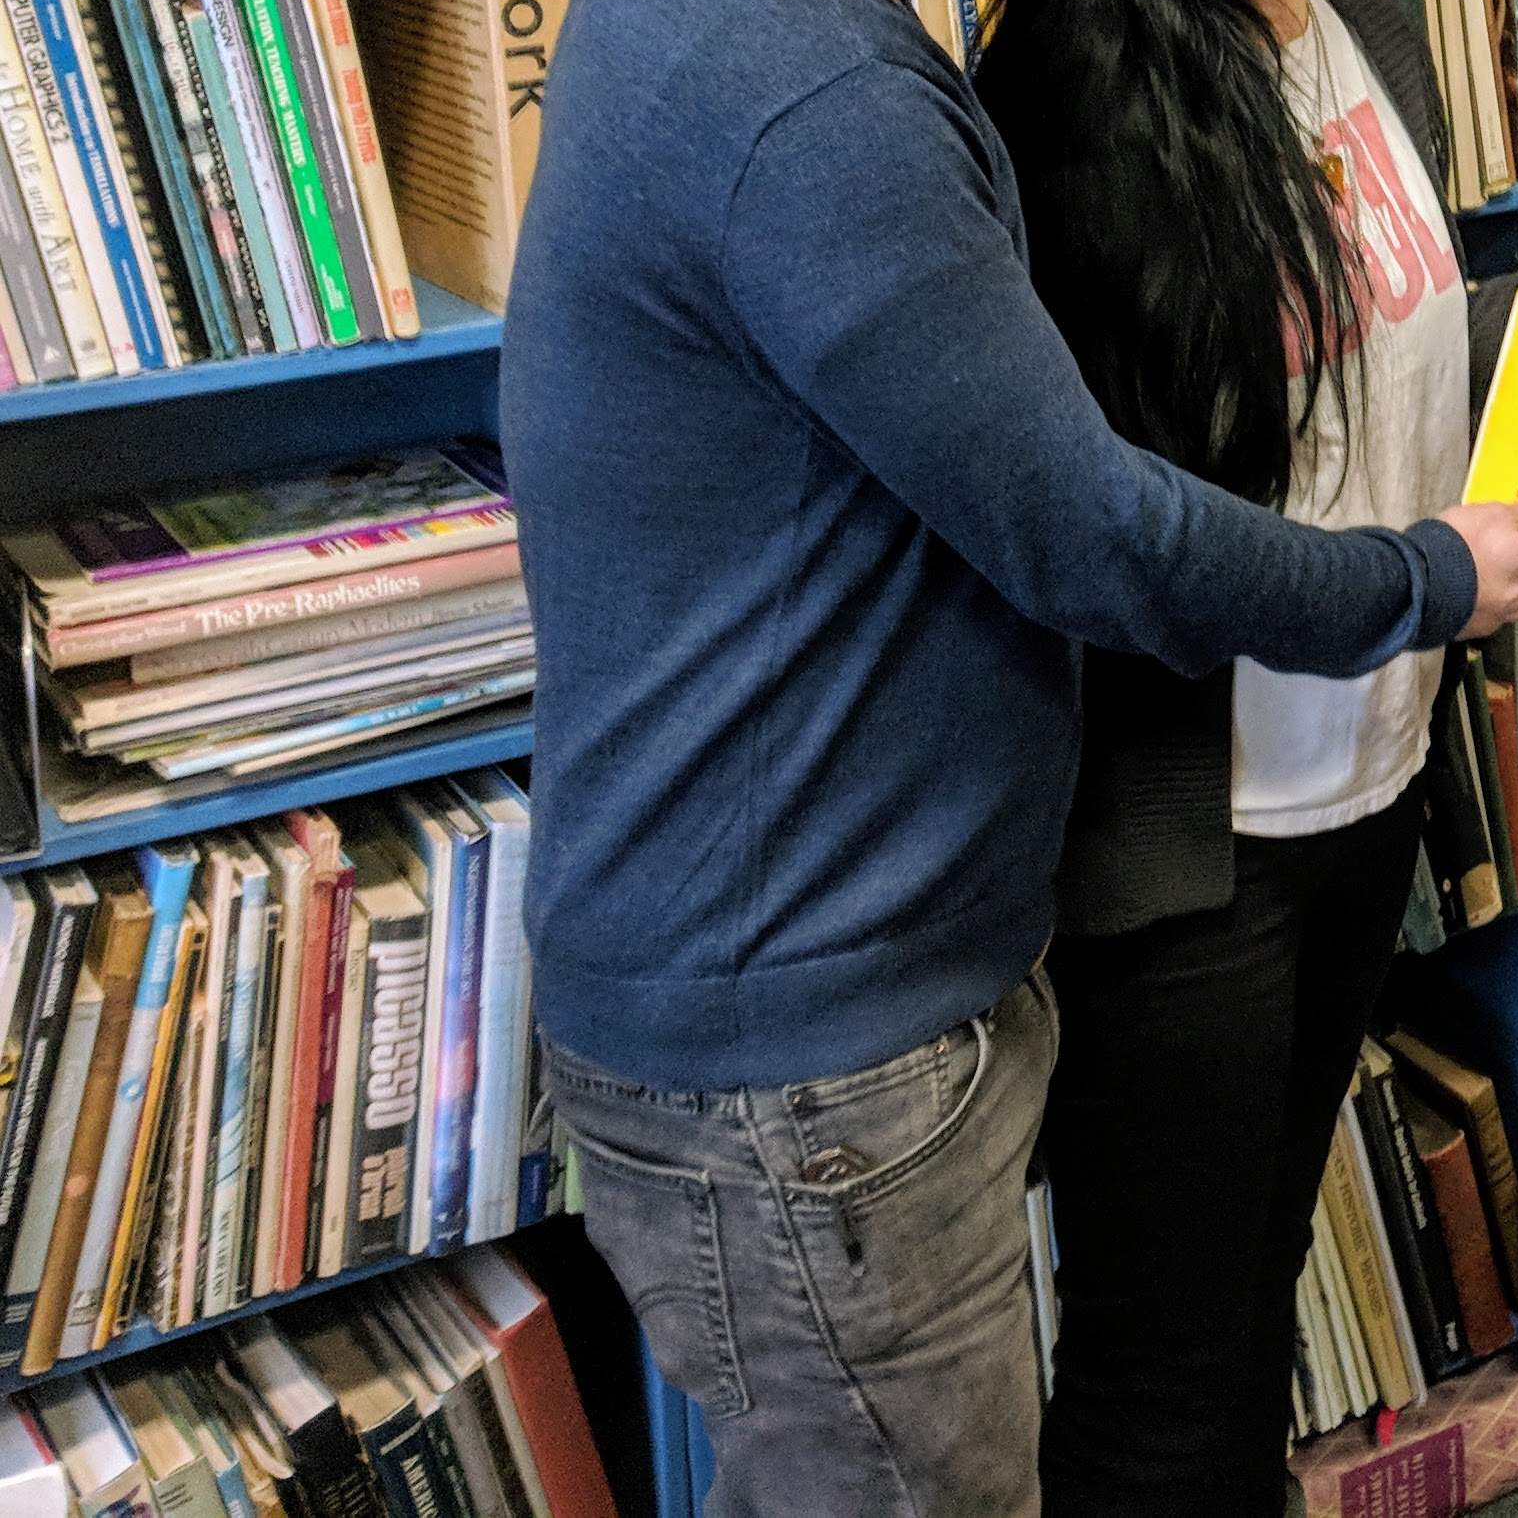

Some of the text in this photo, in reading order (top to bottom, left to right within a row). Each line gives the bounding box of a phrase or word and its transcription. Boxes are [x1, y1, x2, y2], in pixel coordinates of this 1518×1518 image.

[25, 46, 65, 131] GRAPHICS
[48, 129, 69, 146] 2
[0, 82, 80, 297] HOME with ART
[194, 571, 421, 636] The Pre-Raphaelites
[364, 938, 428, 1133] picasso
